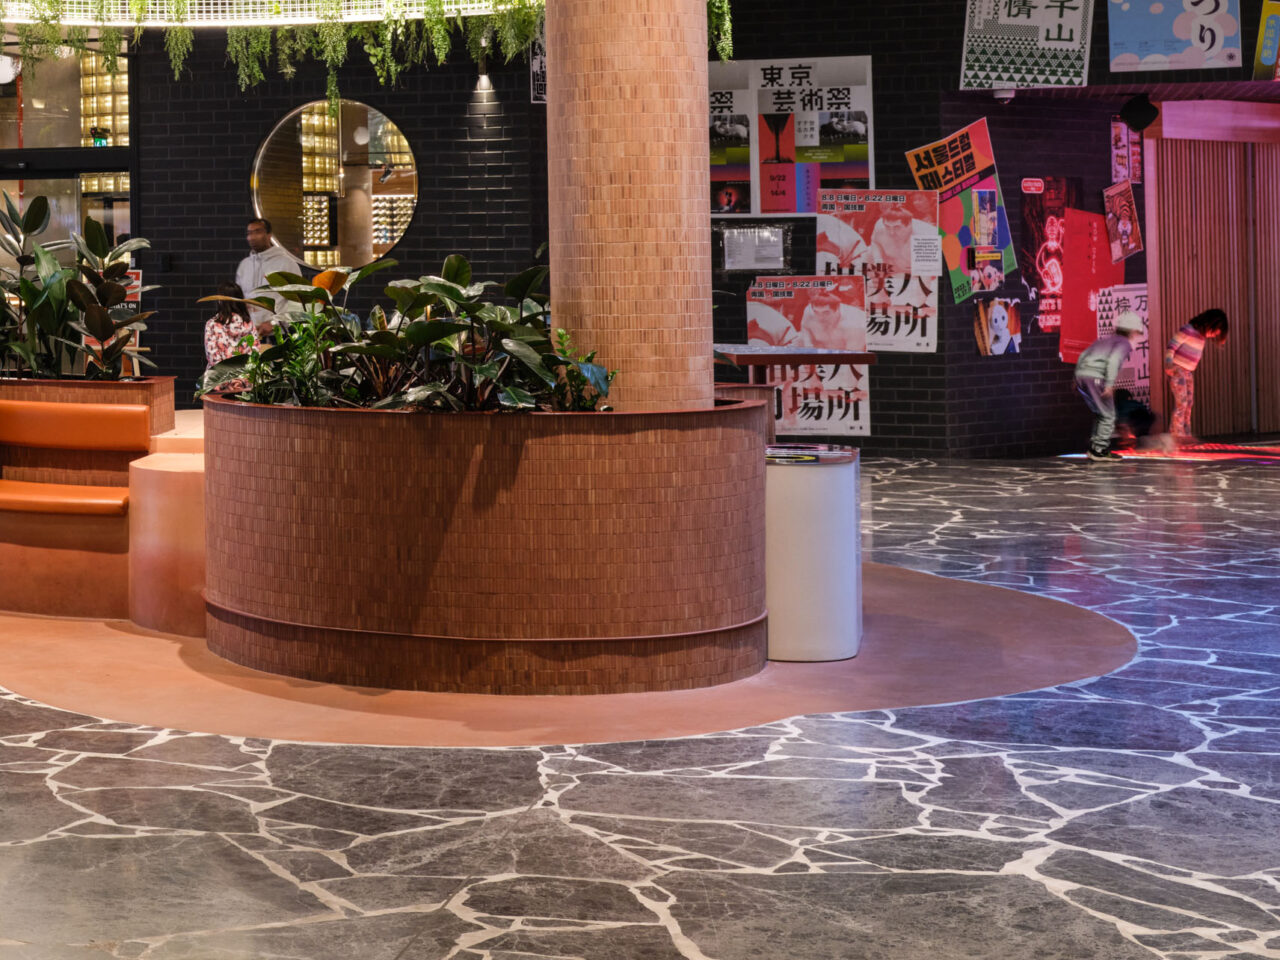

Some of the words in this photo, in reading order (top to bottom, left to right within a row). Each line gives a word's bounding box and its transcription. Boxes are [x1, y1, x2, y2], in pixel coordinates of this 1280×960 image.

[761, 64, 812, 87] 東京
[710, 91, 733, 113] 祭
[772, 87, 851, 112] 芸術祭
[914, 131, 972, 172] 서울드럼
[918, 151, 976, 190] 페스티벌
